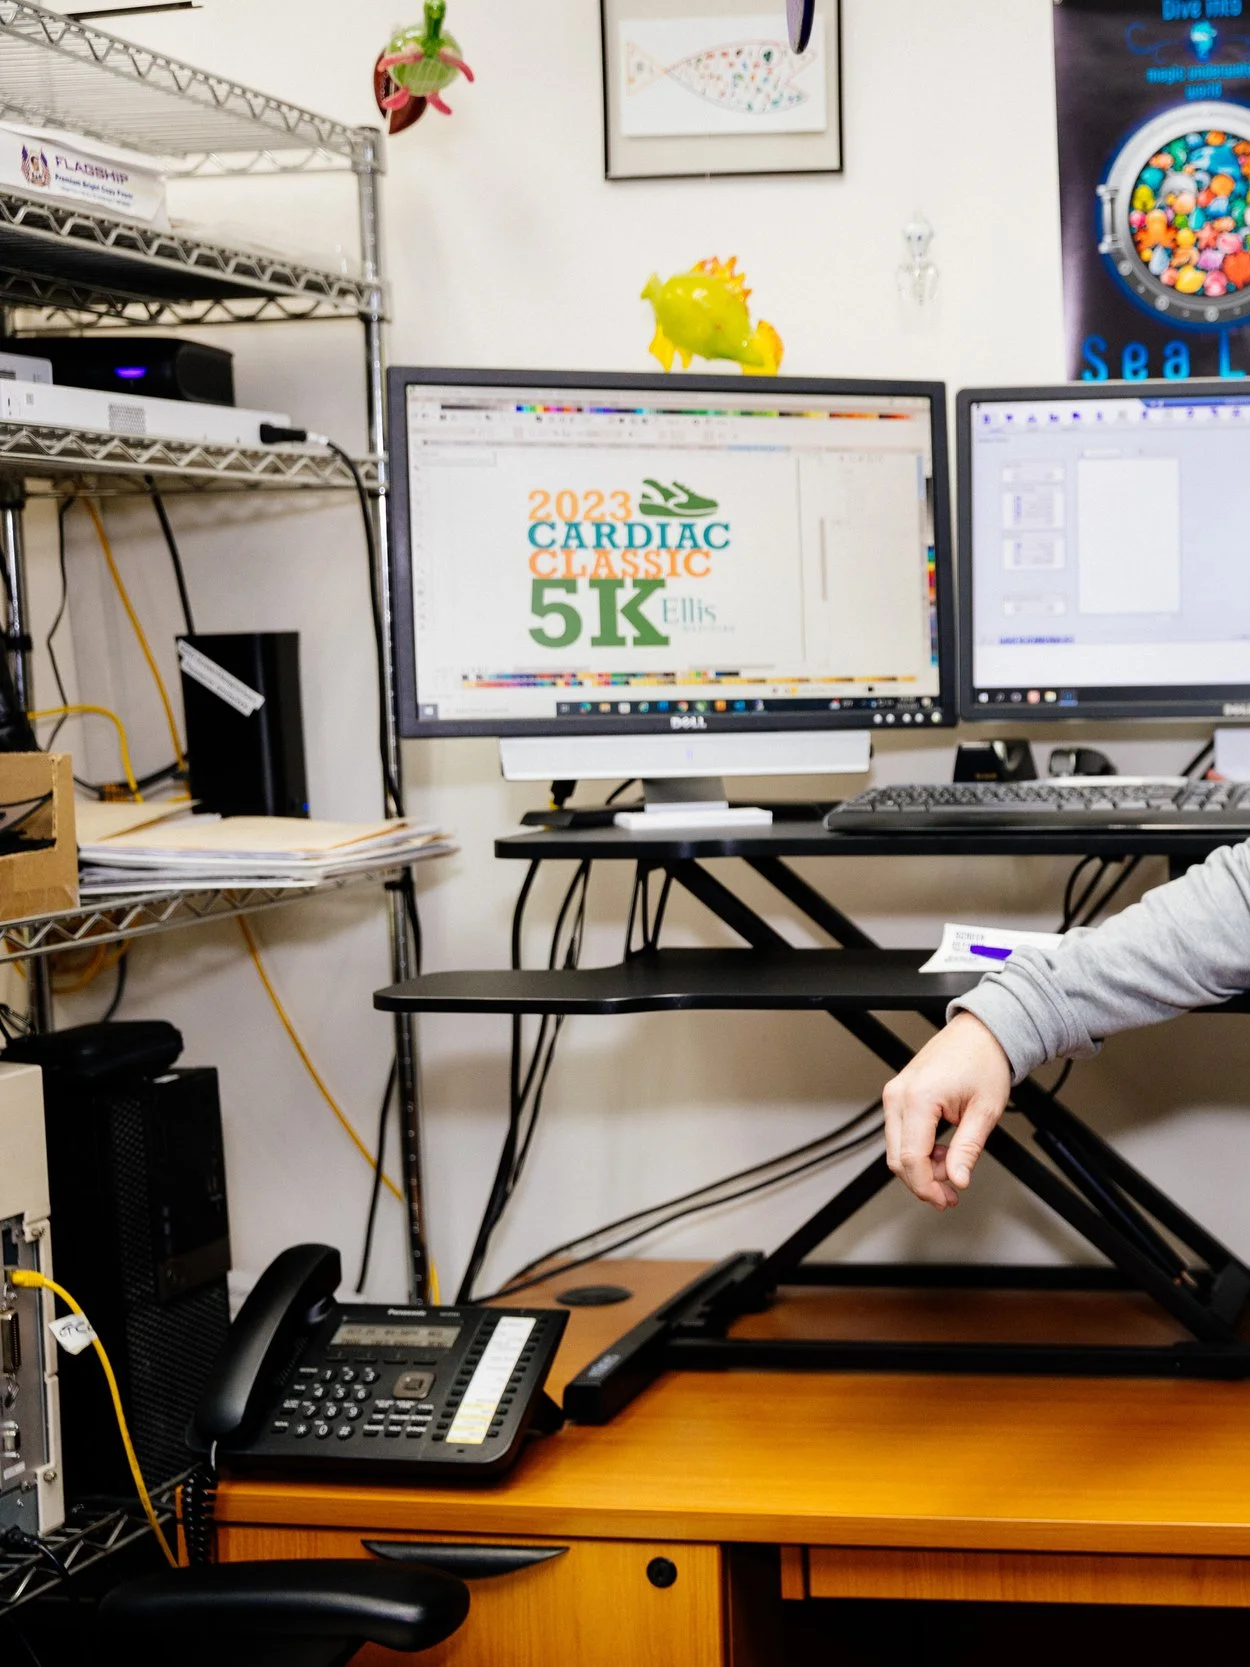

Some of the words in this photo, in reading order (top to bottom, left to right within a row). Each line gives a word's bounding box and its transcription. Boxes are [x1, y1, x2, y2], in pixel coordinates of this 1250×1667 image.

[1184, 81, 1222, 100] world
[55, 155, 129, 185] FLAGSHIP
[55, 173, 81, 187] Premium
[1081, 334, 1191, 382] Sea
[528, 489, 633, 522] 2023
[528, 521, 731, 550] CARDIAC
[528, 548, 712, 579] CLASSIC
[528, 578, 670, 649] 5K
[661, 597, 717, 625] Ellis
[670, 715, 708, 730] DELL
[387, 1308, 427, 1317] Panasonic
[325, 1369, 332, 1380] 1
[343, 1370, 354, 1381] 2
[365, 1371, 375, 1382] 3
[357, 1388, 367, 1400] 6
[348, 1406, 358, 1418] 9
[319, 1424, 329, 1436] 0
